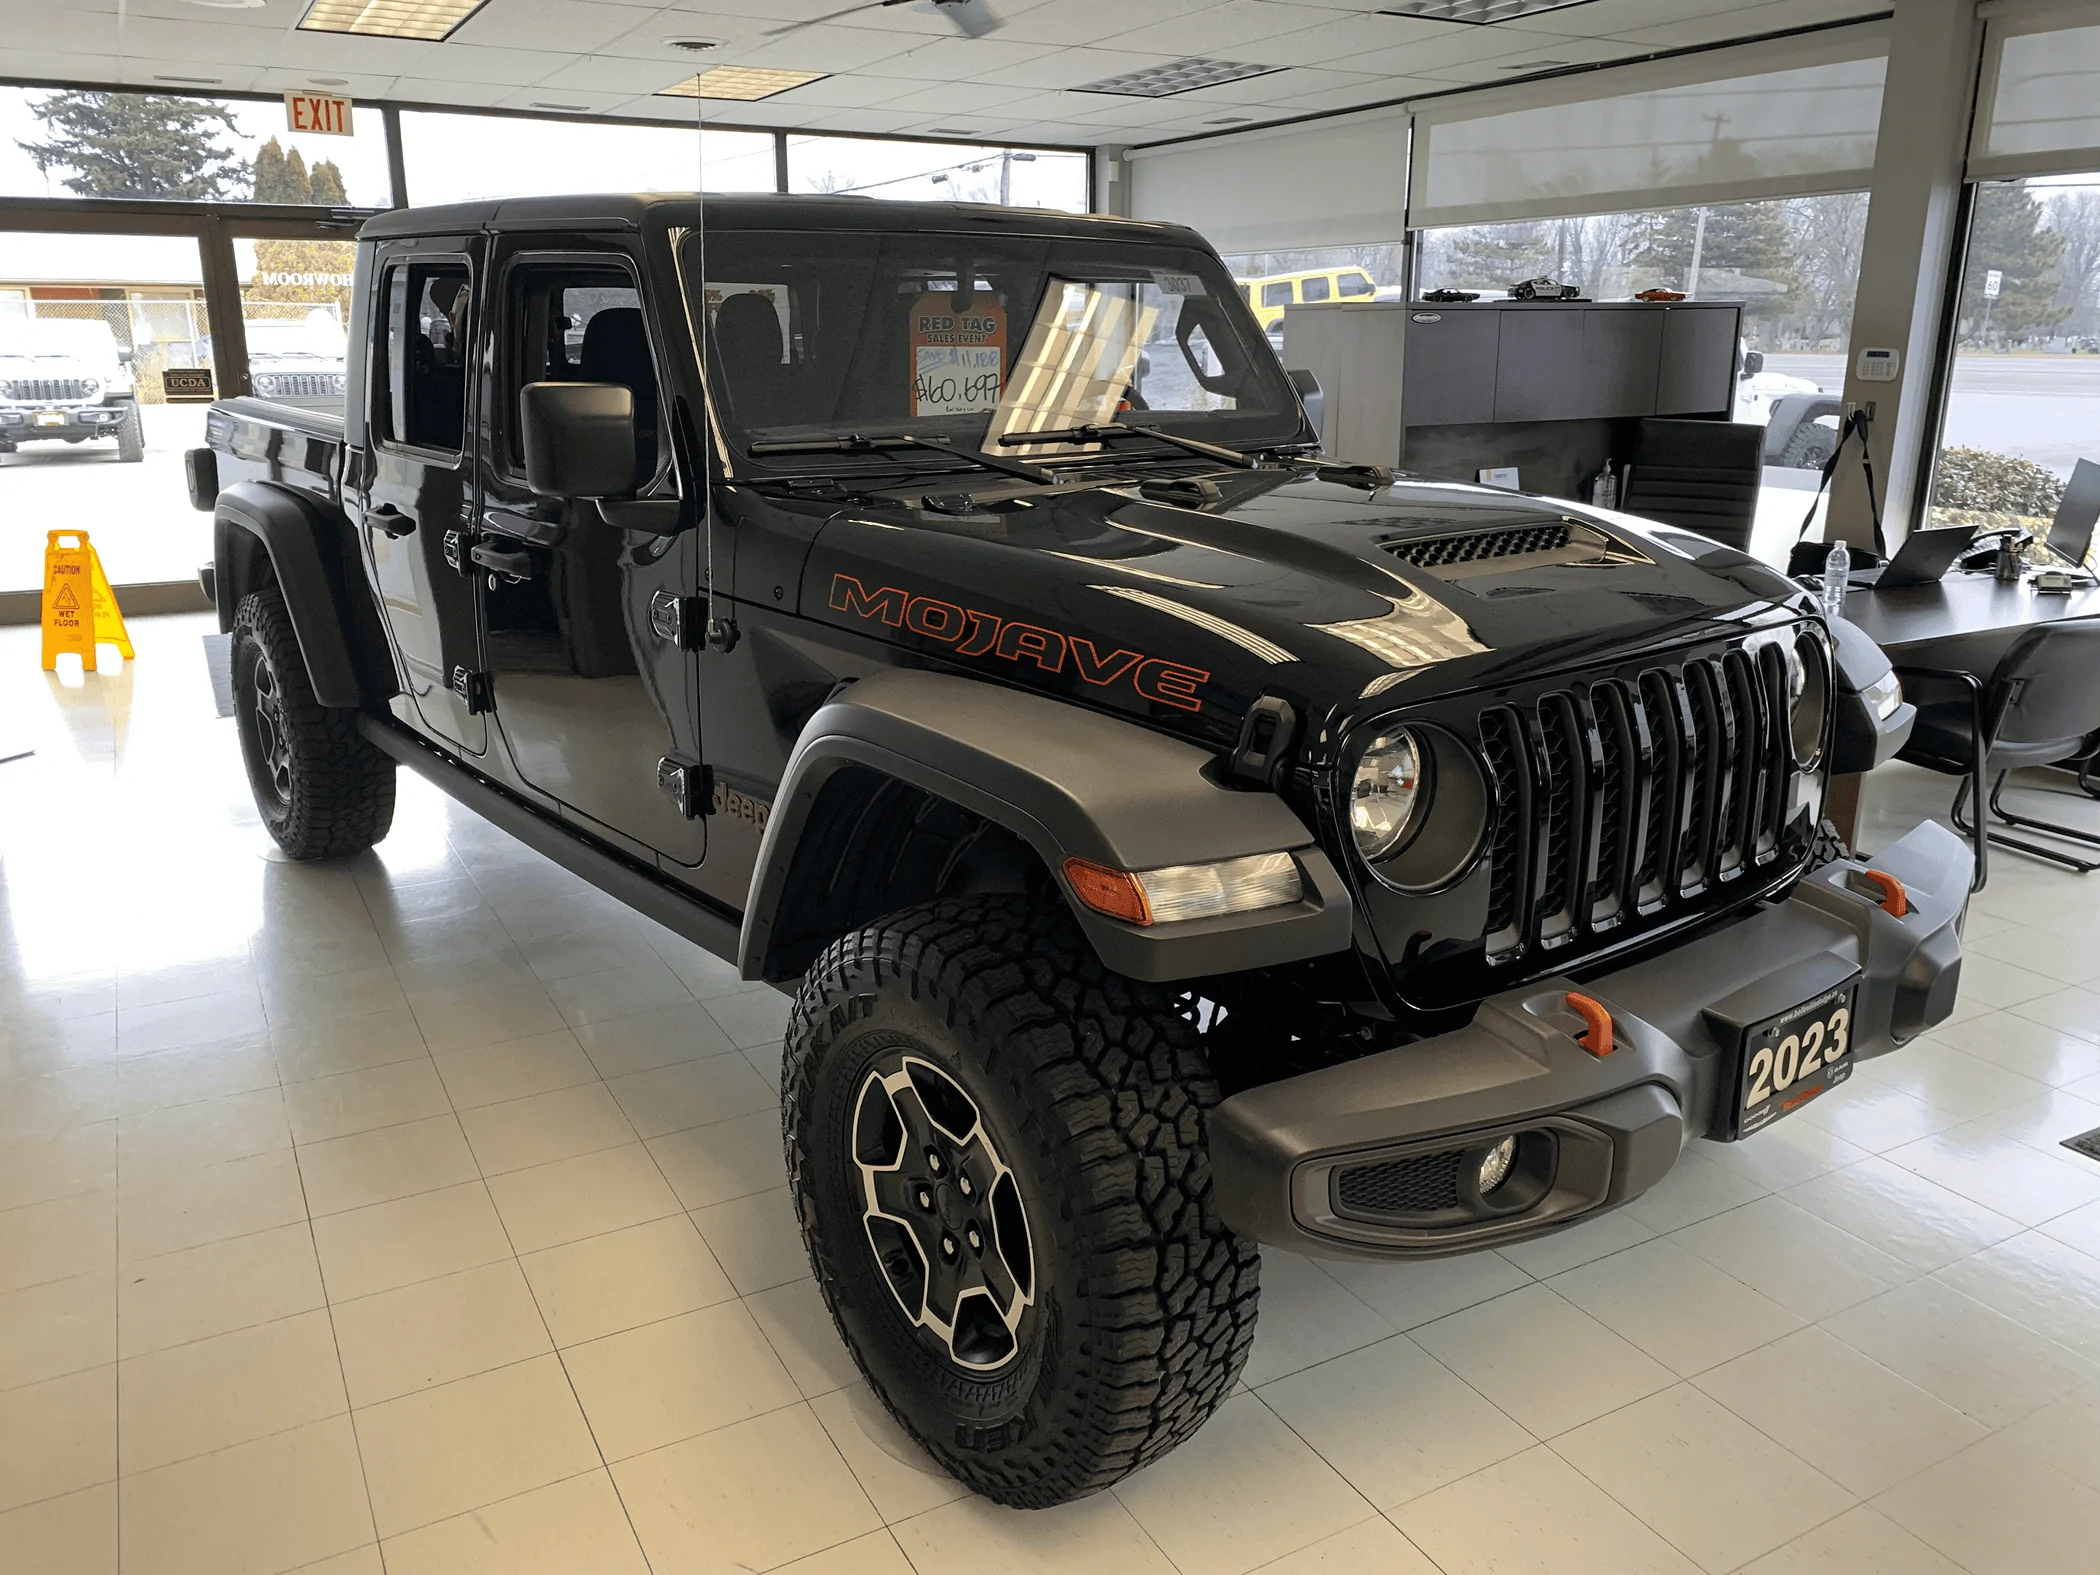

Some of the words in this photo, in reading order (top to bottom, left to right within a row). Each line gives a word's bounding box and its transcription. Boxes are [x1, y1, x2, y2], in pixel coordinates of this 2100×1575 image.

[293, 97, 345, 132] EXIT
[1988, 281, 1998, 291] 60
[919, 316, 954, 333] RED
[960, 317, 997, 334] TAG
[927, 334, 955, 343] SALES
[958, 334, 987, 344] EVENT
[171, 378, 207, 387] UCDA
[53, 564, 81, 574] CAUTION
[58, 610, 75, 618] WET
[54, 619, 80, 627] FLOOR
[829, 574, 1210, 712] MOJAVE
[712, 781, 770, 836] Jeep
[1746, 1008, 1849, 1110] 2023
